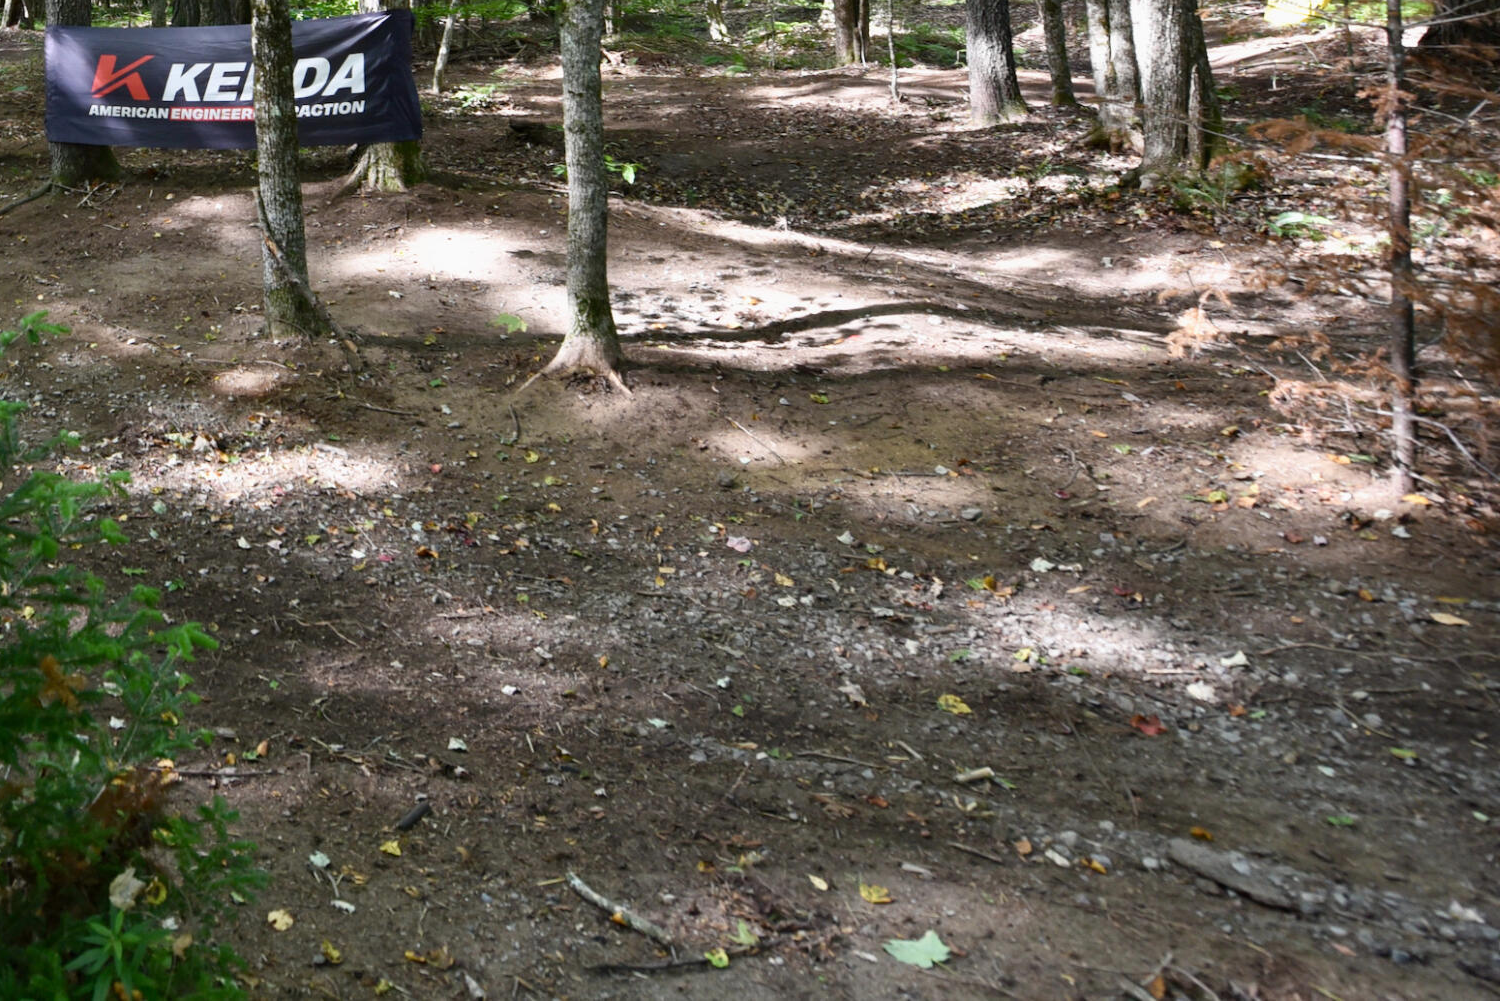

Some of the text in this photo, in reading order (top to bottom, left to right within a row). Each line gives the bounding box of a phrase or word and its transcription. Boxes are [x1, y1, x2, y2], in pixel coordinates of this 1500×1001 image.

[162, 53, 365, 102] KEDA
[89, 100, 365, 120] AMERICAN ENGINEER ACTION
